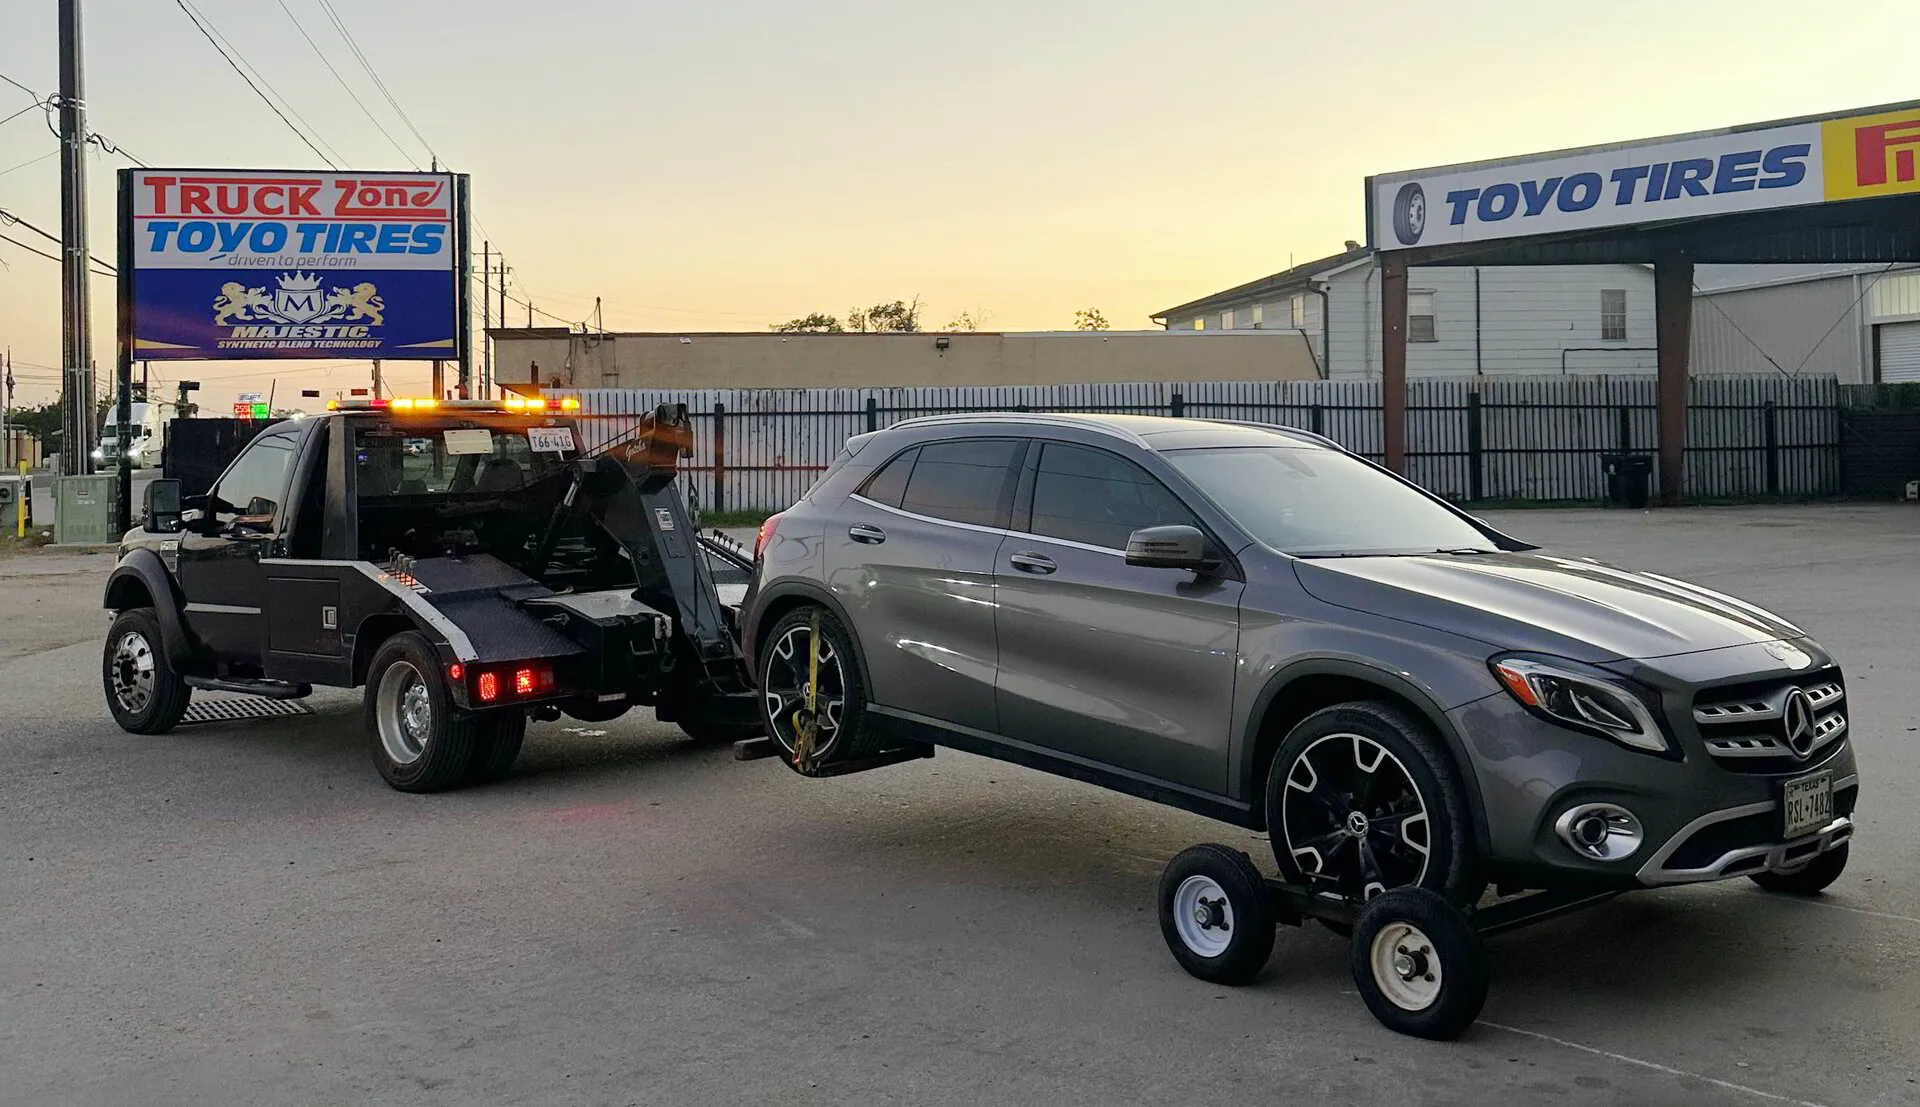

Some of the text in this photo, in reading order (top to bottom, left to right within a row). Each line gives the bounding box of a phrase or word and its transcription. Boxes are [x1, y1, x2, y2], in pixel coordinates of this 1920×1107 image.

[1446, 172, 1603, 226] TOYO
[1609, 144, 1812, 206] TIRES
[143, 176, 322, 216] TRUCK
[147, 221, 446, 254] TOYO TIRES
[228, 253, 357, 269] driven to perform
[284, 295, 316, 312] M
[231, 325, 371, 338] MAJESTIC
[217, 340, 382, 349] SYNTHETIC BLEND TECHNOLOGY
[1801, 780, 1819, 792] TEXAS
